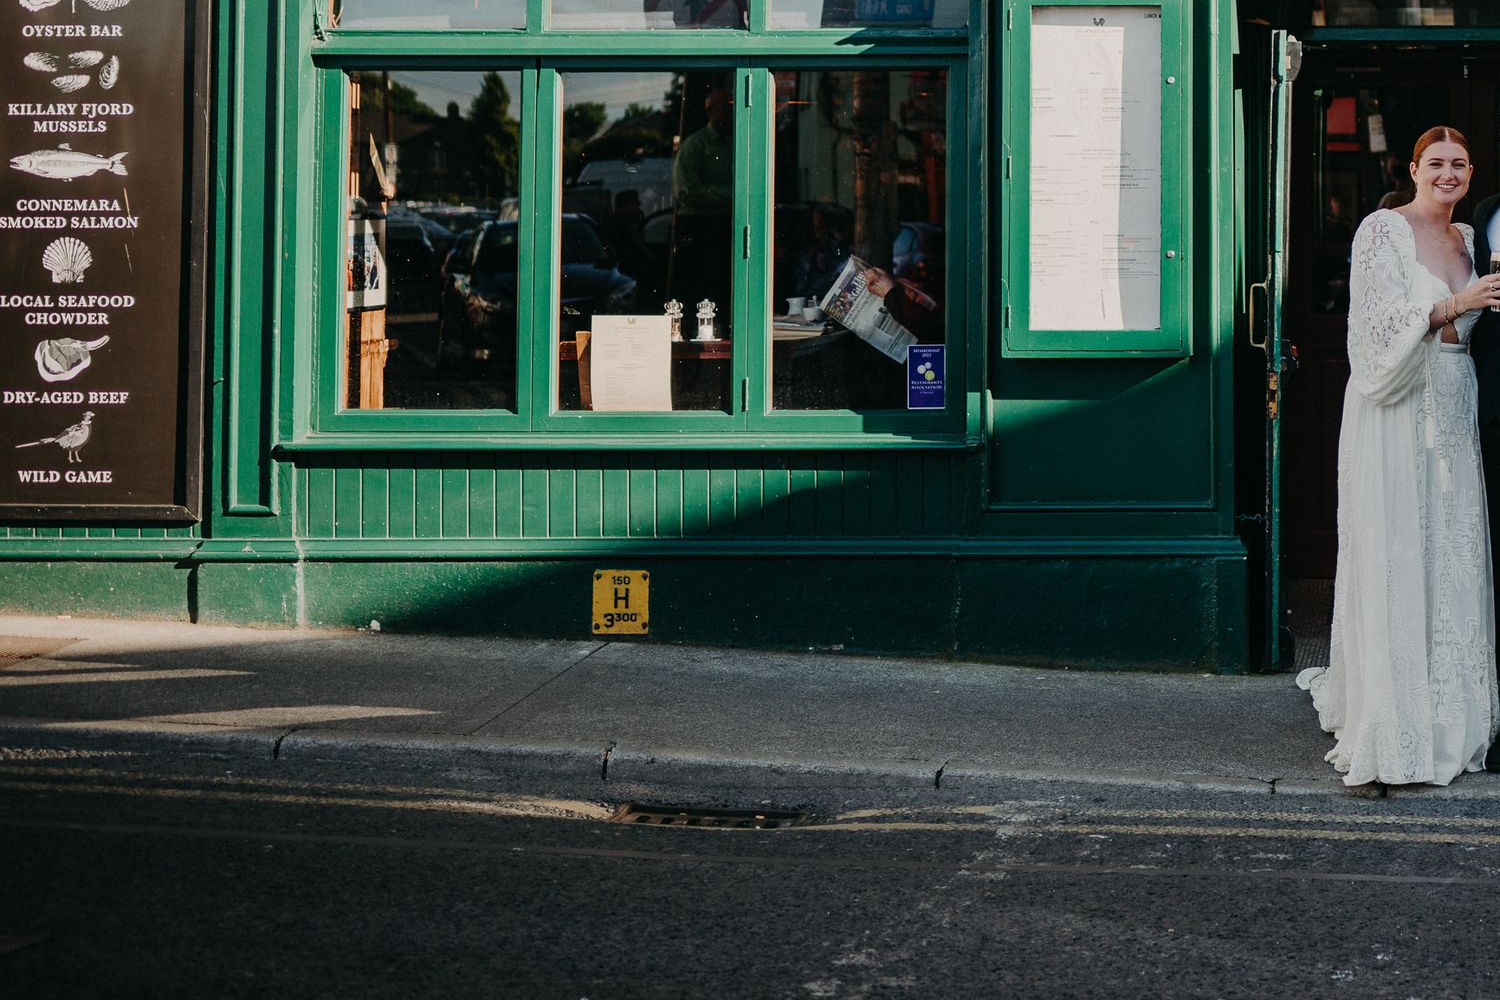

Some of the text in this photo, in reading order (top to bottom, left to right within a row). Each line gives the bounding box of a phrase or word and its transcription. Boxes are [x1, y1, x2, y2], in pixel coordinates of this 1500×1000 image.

[22, 24, 123, 38] OYSTER BAR
[8, 103, 135, 118] KILLARY FJORD
[33, 121, 107, 133] MUSSELS
[16, 199, 122, 212] CONNEMARA
[0, 216, 139, 229] SMOKED SALMON
[0, 295, 136, 308] LOCAL SEAFOOD
[24, 312, 110, 325] CHOWDER
[3, 391, 129, 404] DRY-AGED BEEF
[17, 470, 113, 483] WILD GAME
[612, 576, 631, 585] 150
[614, 588, 629, 609] H
